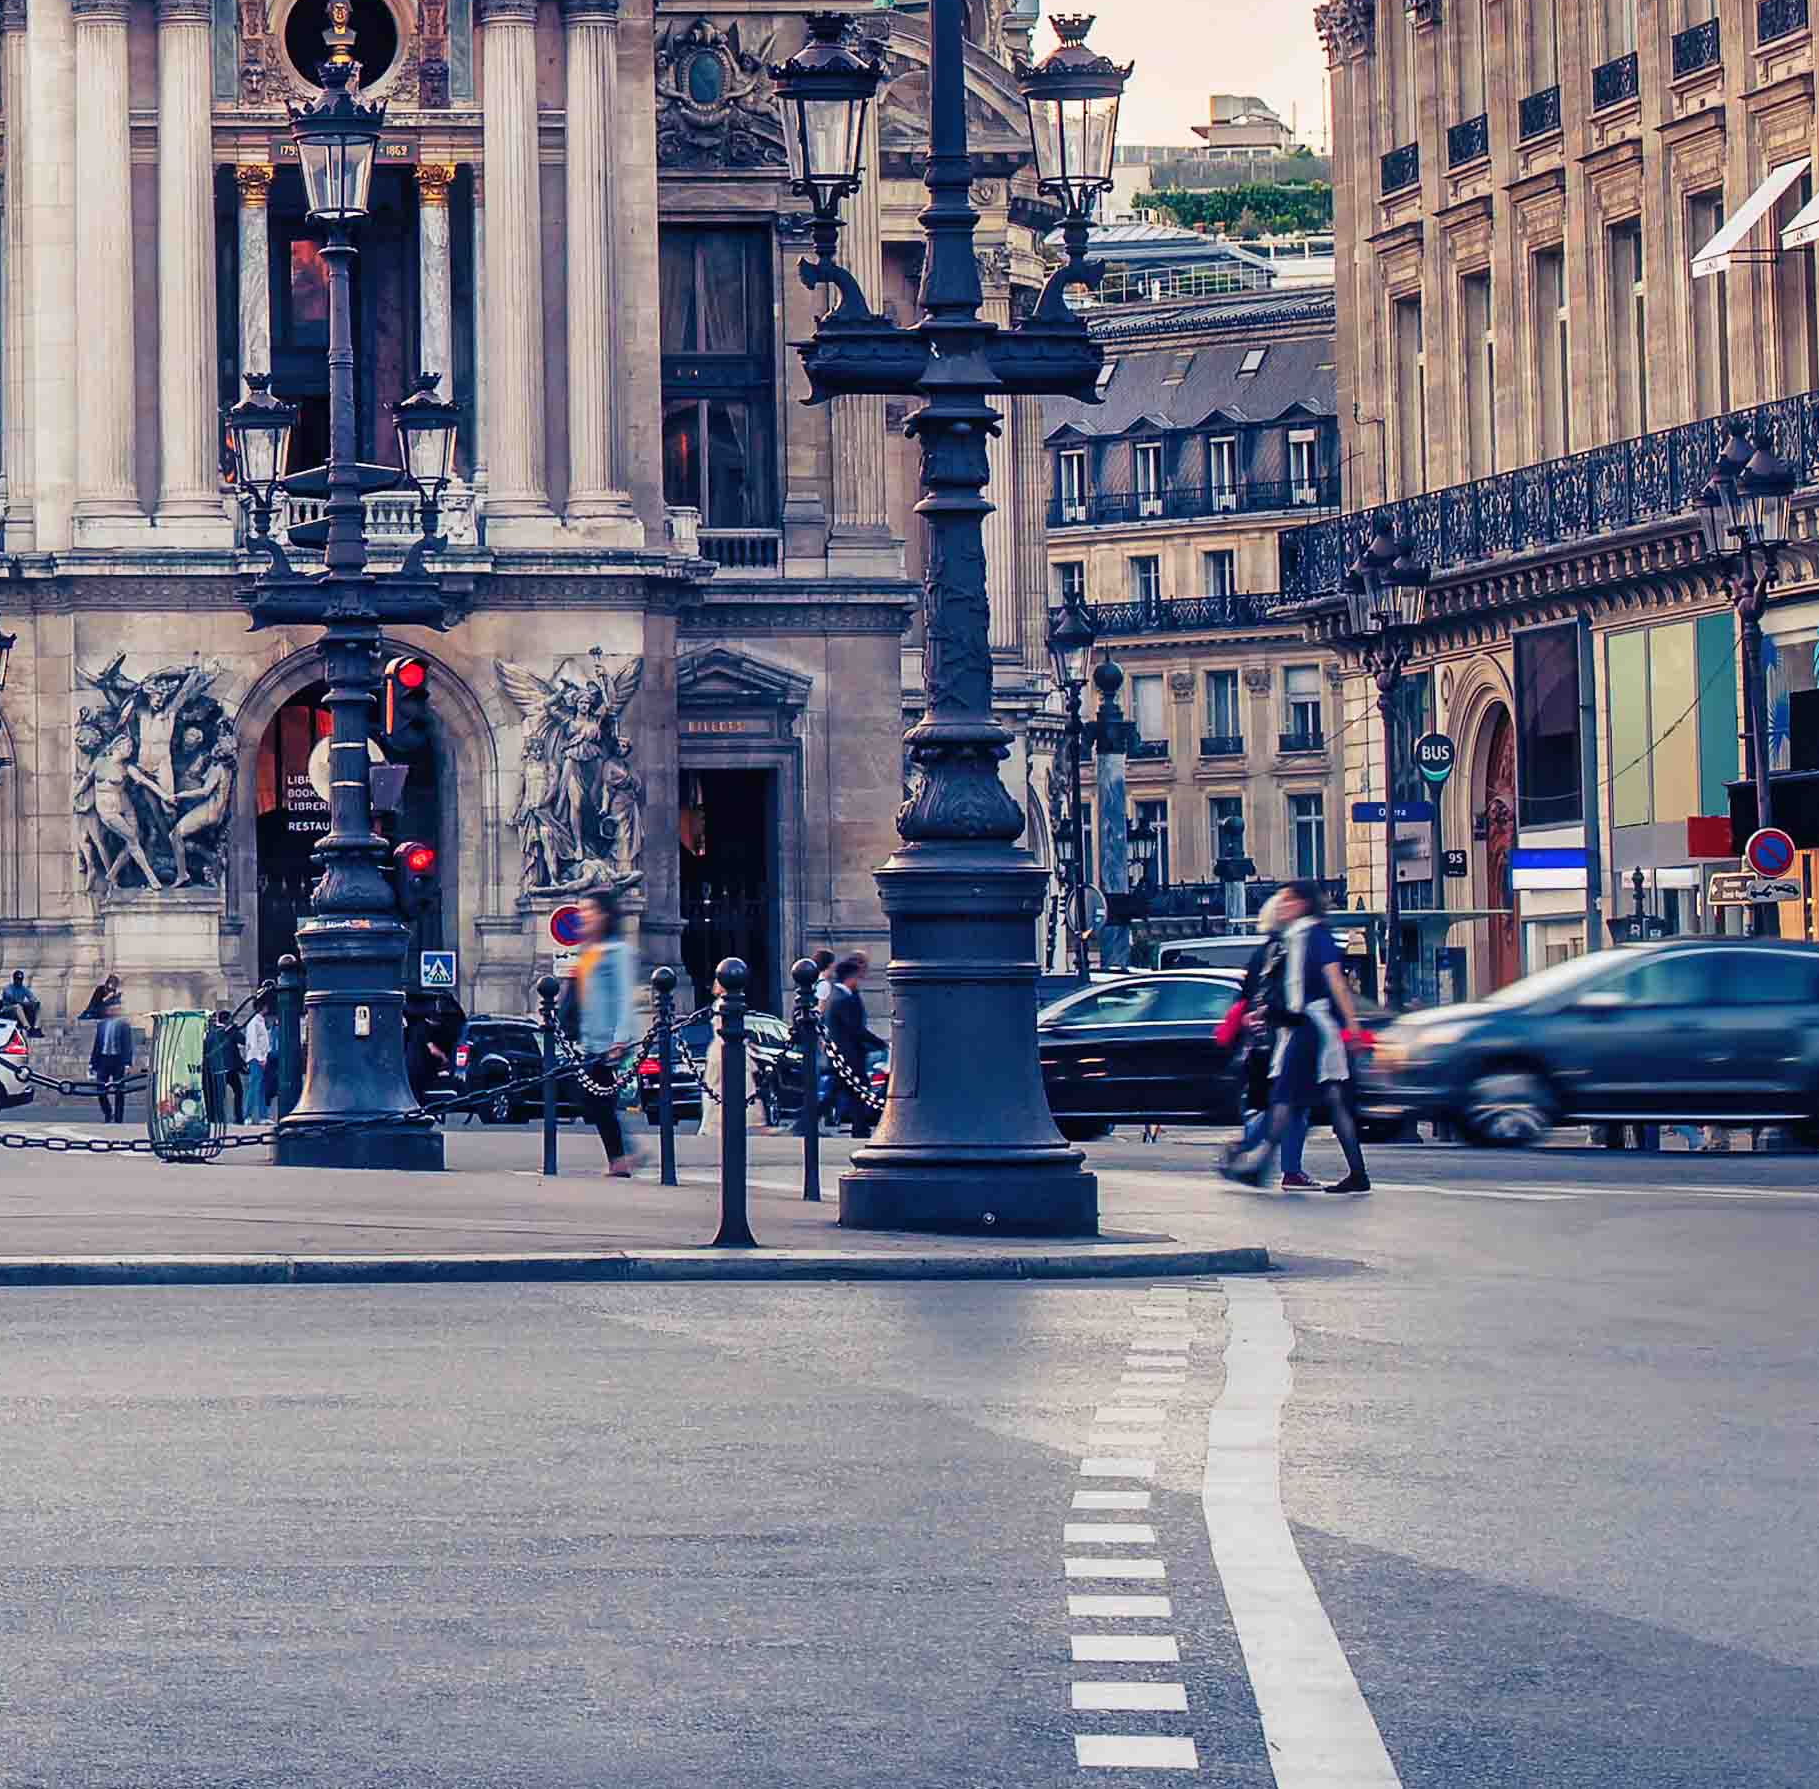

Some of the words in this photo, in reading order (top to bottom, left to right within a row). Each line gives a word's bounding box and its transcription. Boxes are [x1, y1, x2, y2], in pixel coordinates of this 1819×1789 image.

[1421, 745, 1451, 761] BUS
[1378, 807, 1407, 817] Ora
[287, 821, 331, 831] RESTAU
[1448, 853, 1463, 864] 95
